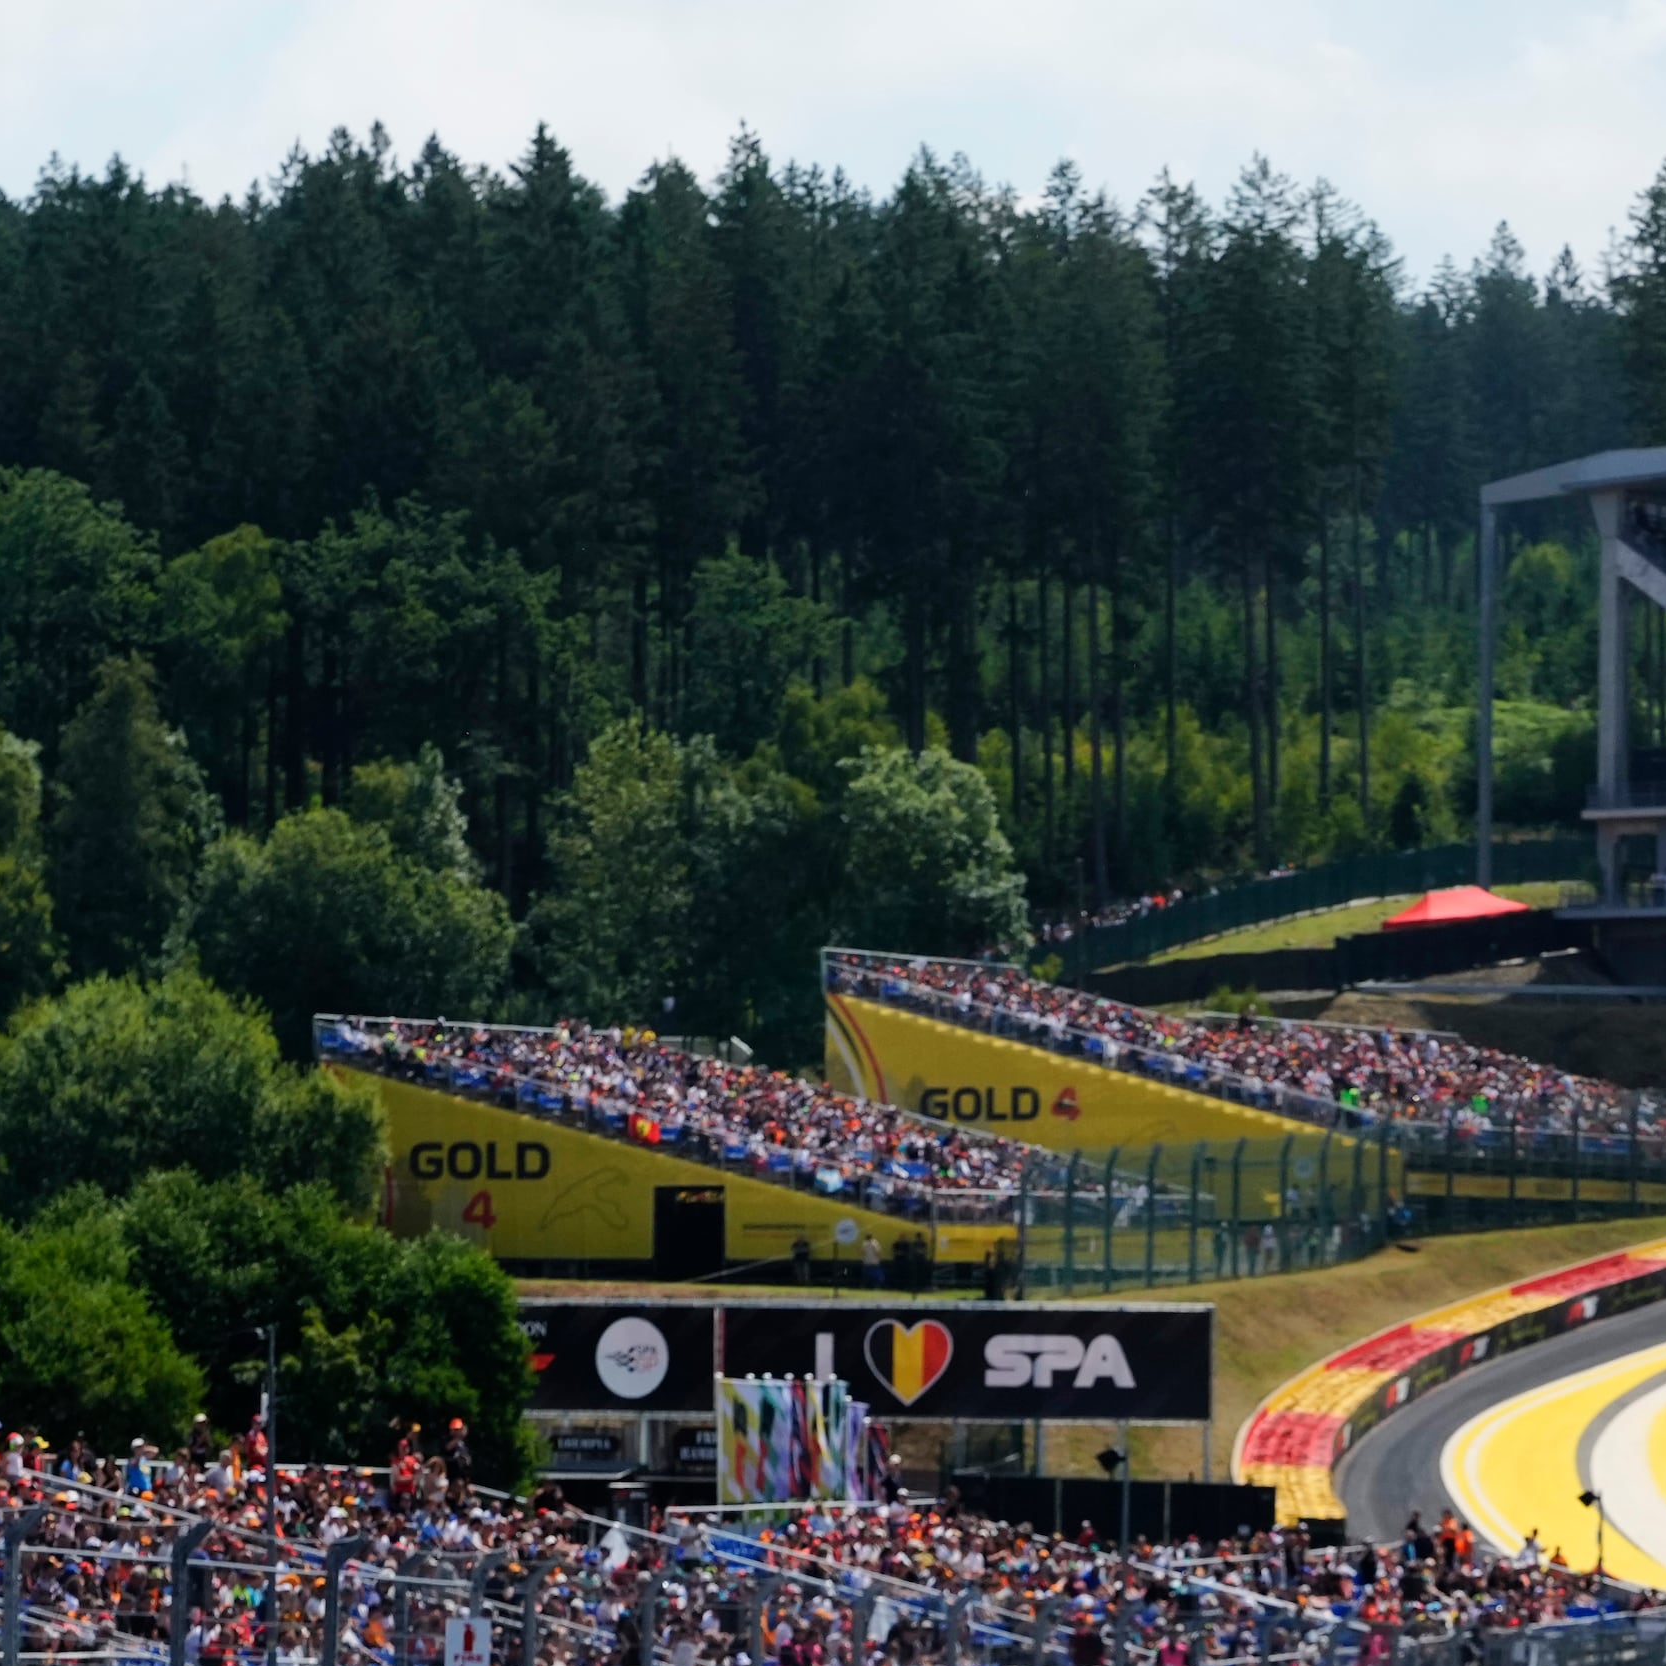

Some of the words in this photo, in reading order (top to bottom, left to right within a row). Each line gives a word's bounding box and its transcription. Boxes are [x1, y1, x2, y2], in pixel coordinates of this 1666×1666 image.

[919, 1086, 1042, 1122] GOLD
[1050, 1086, 1082, 1122] 4
[408, 1140, 551, 1181] GOLD
[461, 1188, 498, 1230] 4
[983, 1332, 1137, 1389] SPA
